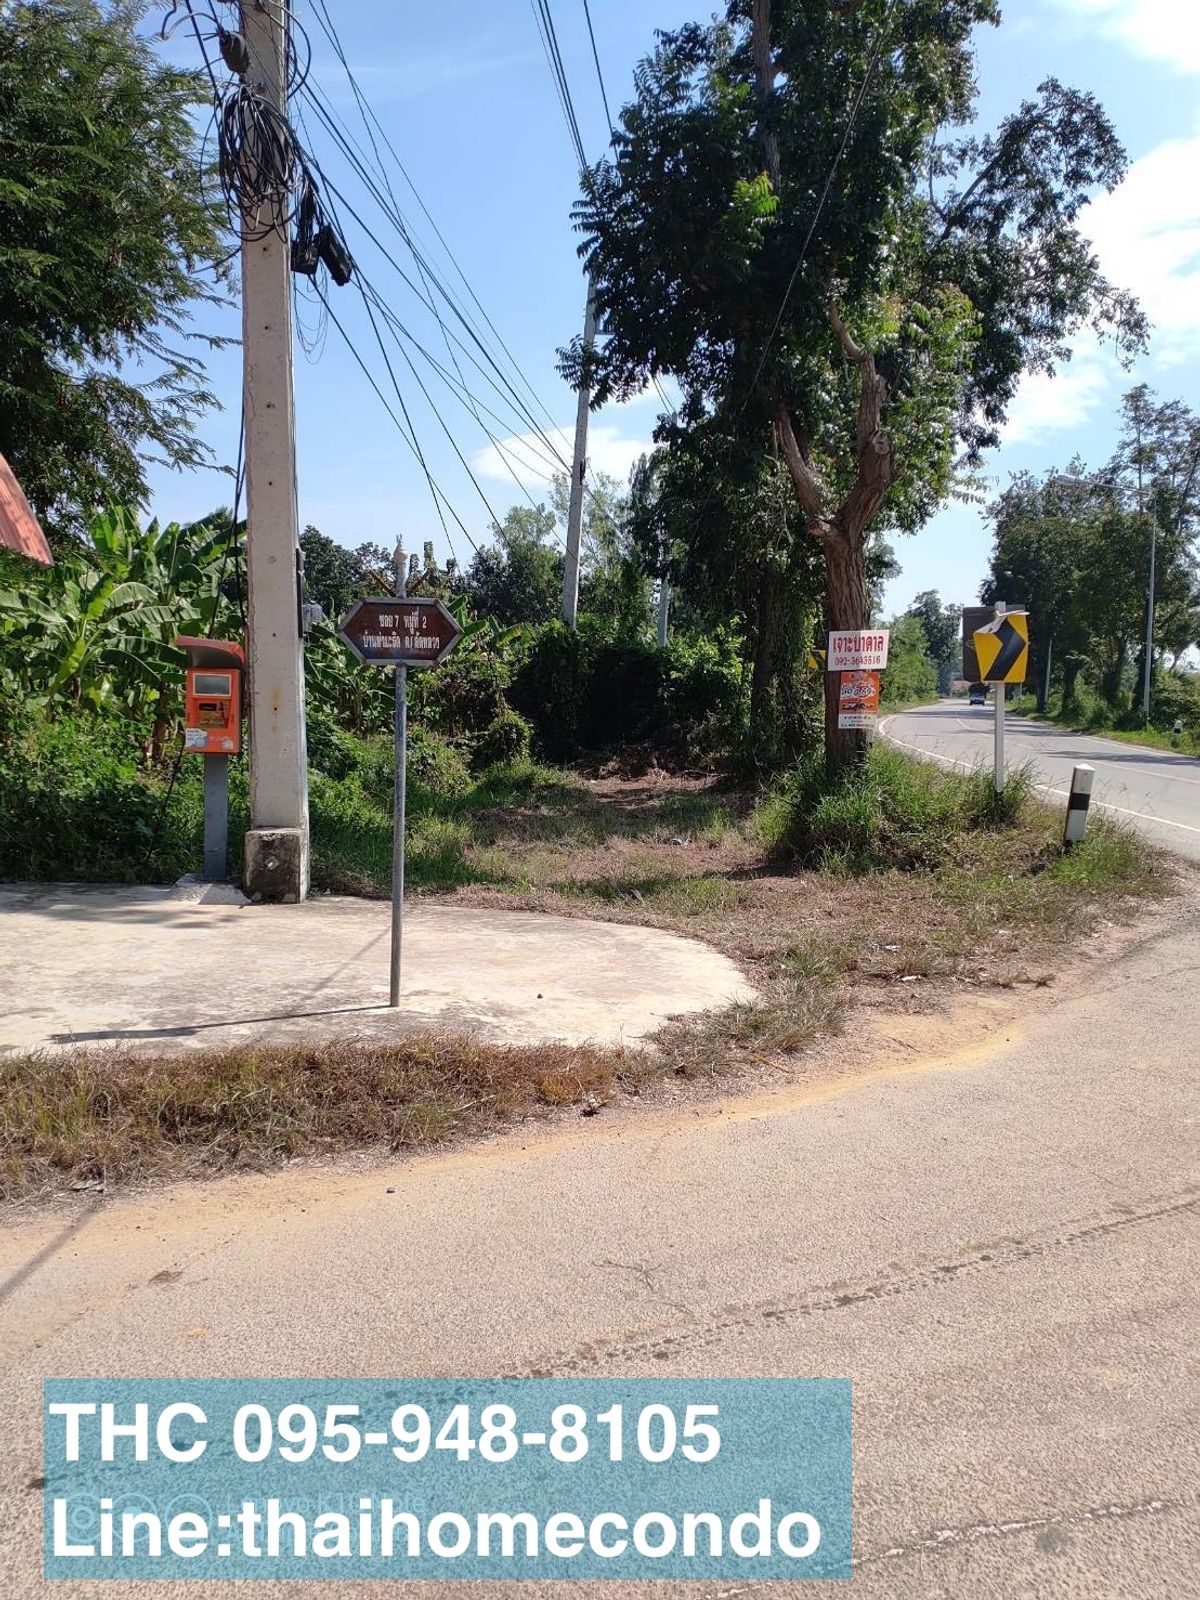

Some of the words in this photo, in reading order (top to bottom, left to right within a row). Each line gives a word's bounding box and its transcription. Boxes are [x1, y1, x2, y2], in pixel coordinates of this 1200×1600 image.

[394, 615, 400, 628] 7
[422, 615, 428, 629] 2
[833, 635, 884, 653] เจาะบาดาล
